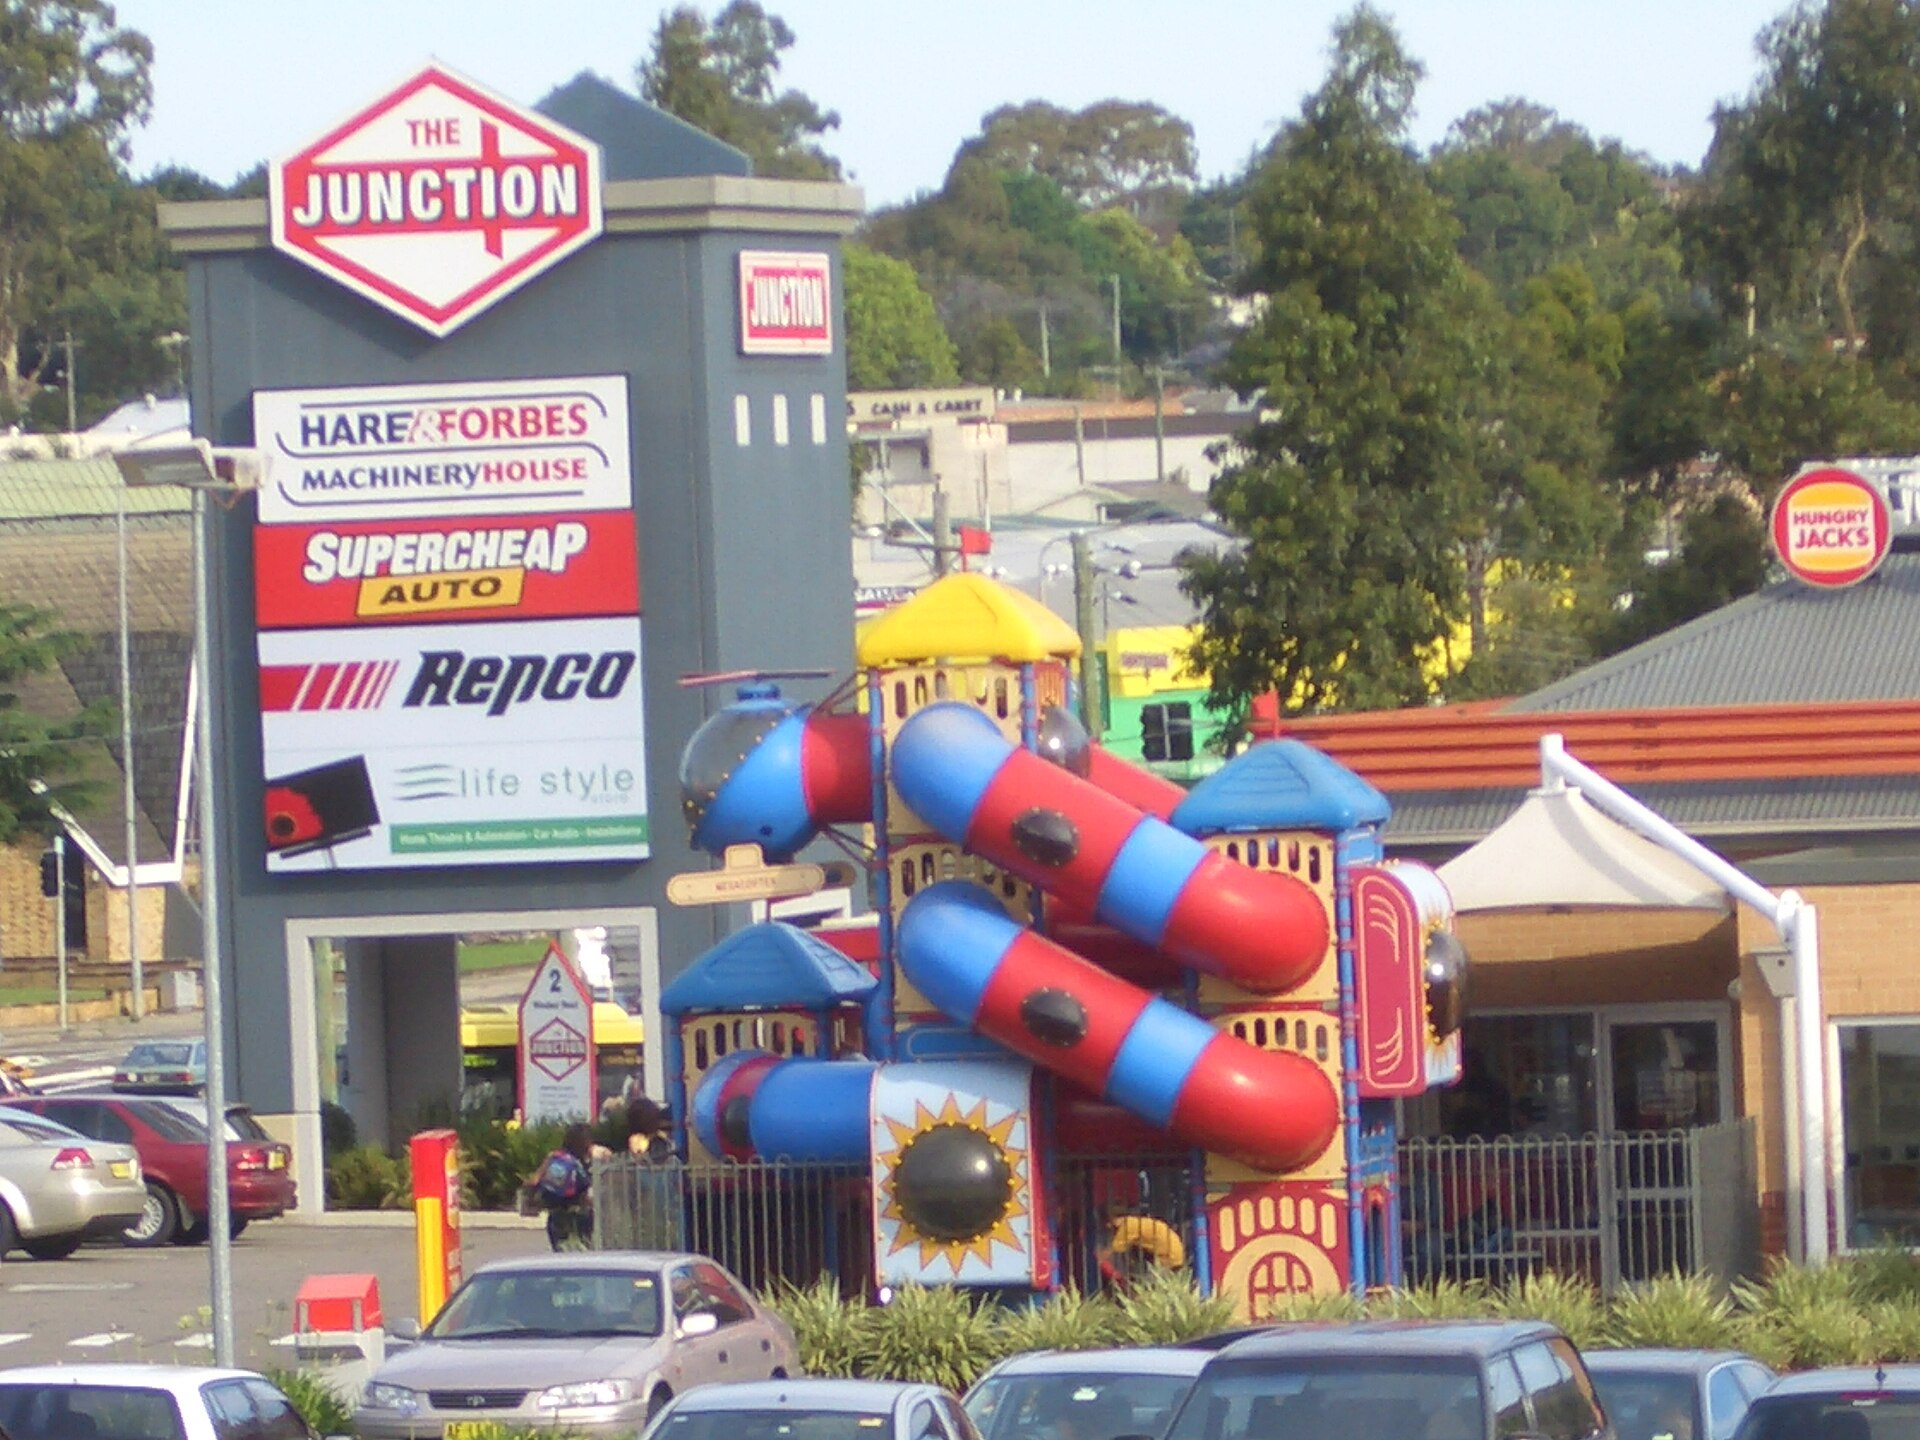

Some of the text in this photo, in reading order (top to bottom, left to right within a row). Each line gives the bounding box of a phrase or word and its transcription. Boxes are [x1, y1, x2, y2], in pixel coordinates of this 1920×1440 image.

[406, 118, 460, 146] THE
[292, 163, 578, 227] JUNCTION
[751, 275, 824, 327] JUNCTION
[871, 402, 911, 416] CASH
[934, 399, 982, 413] CARRY
[1794, 509, 1868, 525] HUNGRY
[303, 522, 589, 583] SUPERCHEAP
[380, 576, 503, 606] AUTO
[460, 762, 634, 802] life style
[550, 969, 561, 993] 2
